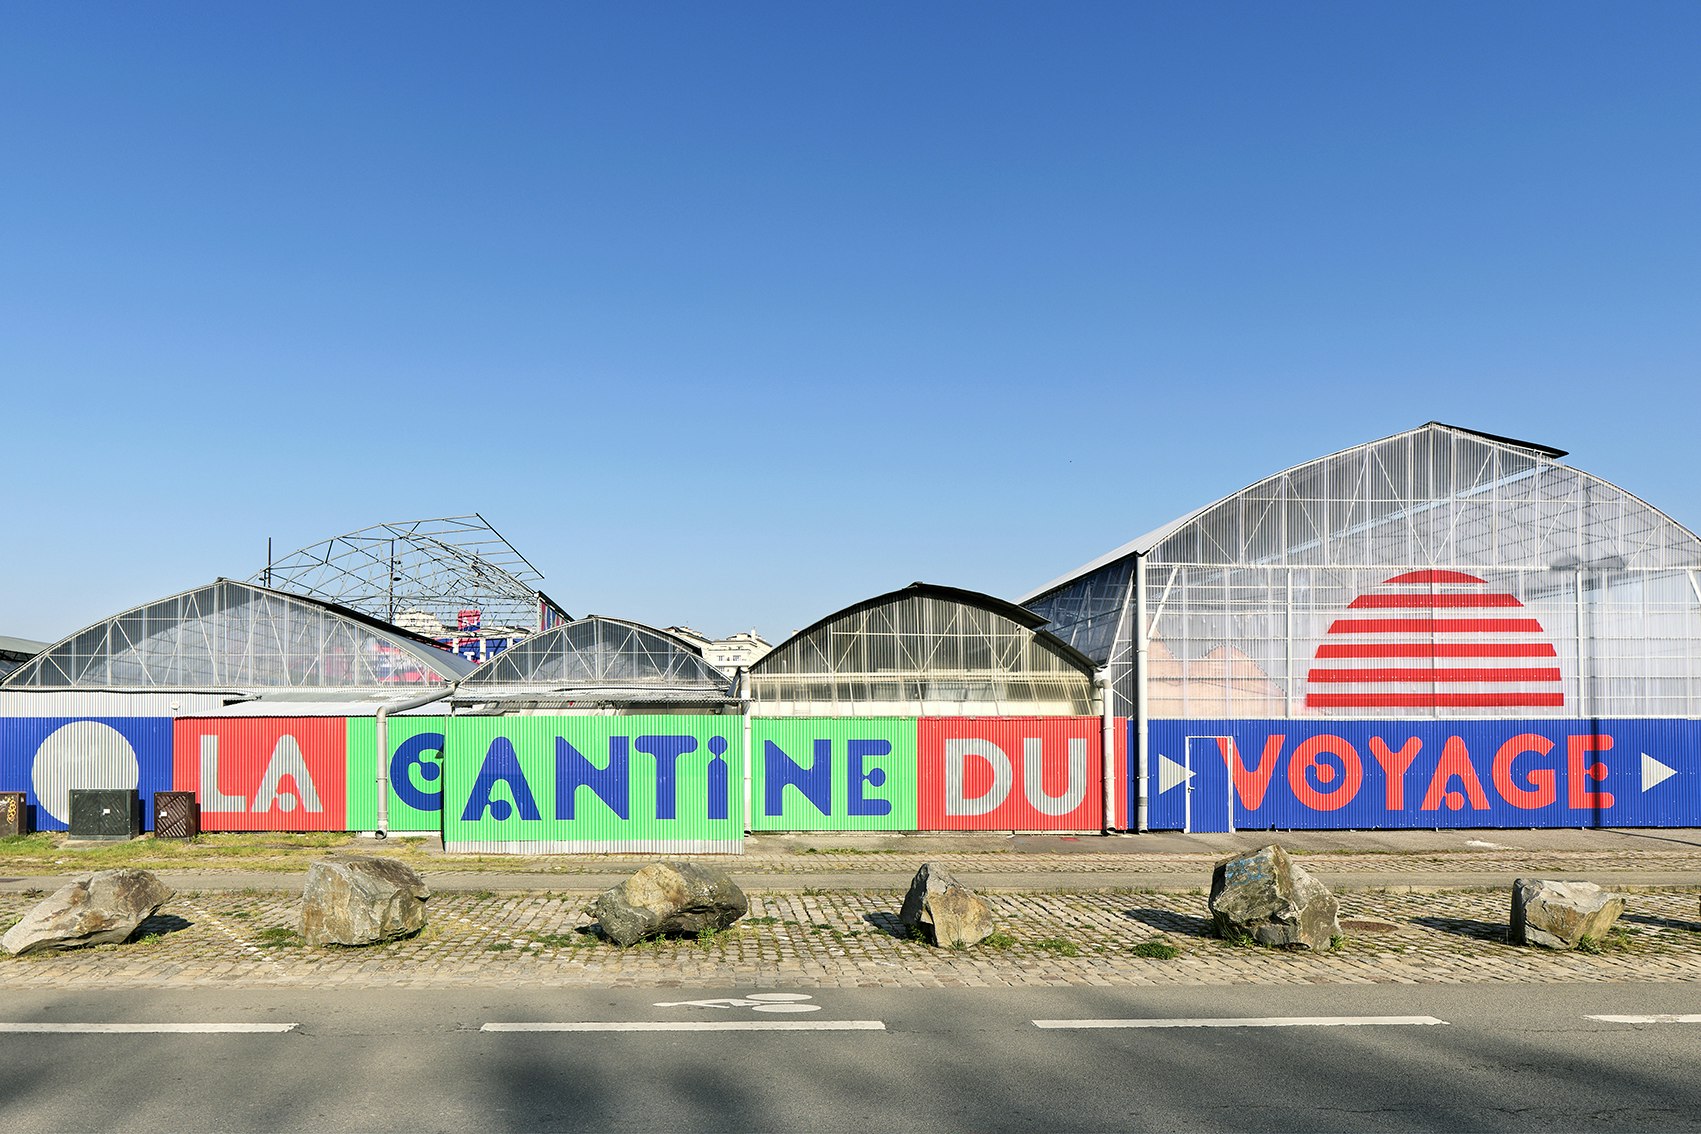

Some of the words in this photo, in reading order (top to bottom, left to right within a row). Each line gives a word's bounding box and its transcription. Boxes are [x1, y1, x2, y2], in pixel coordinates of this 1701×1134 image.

[200, 734, 323, 813] LA
[945, 738, 1087, 816] DU
[1216, 733, 1615, 811] VOYAGE
